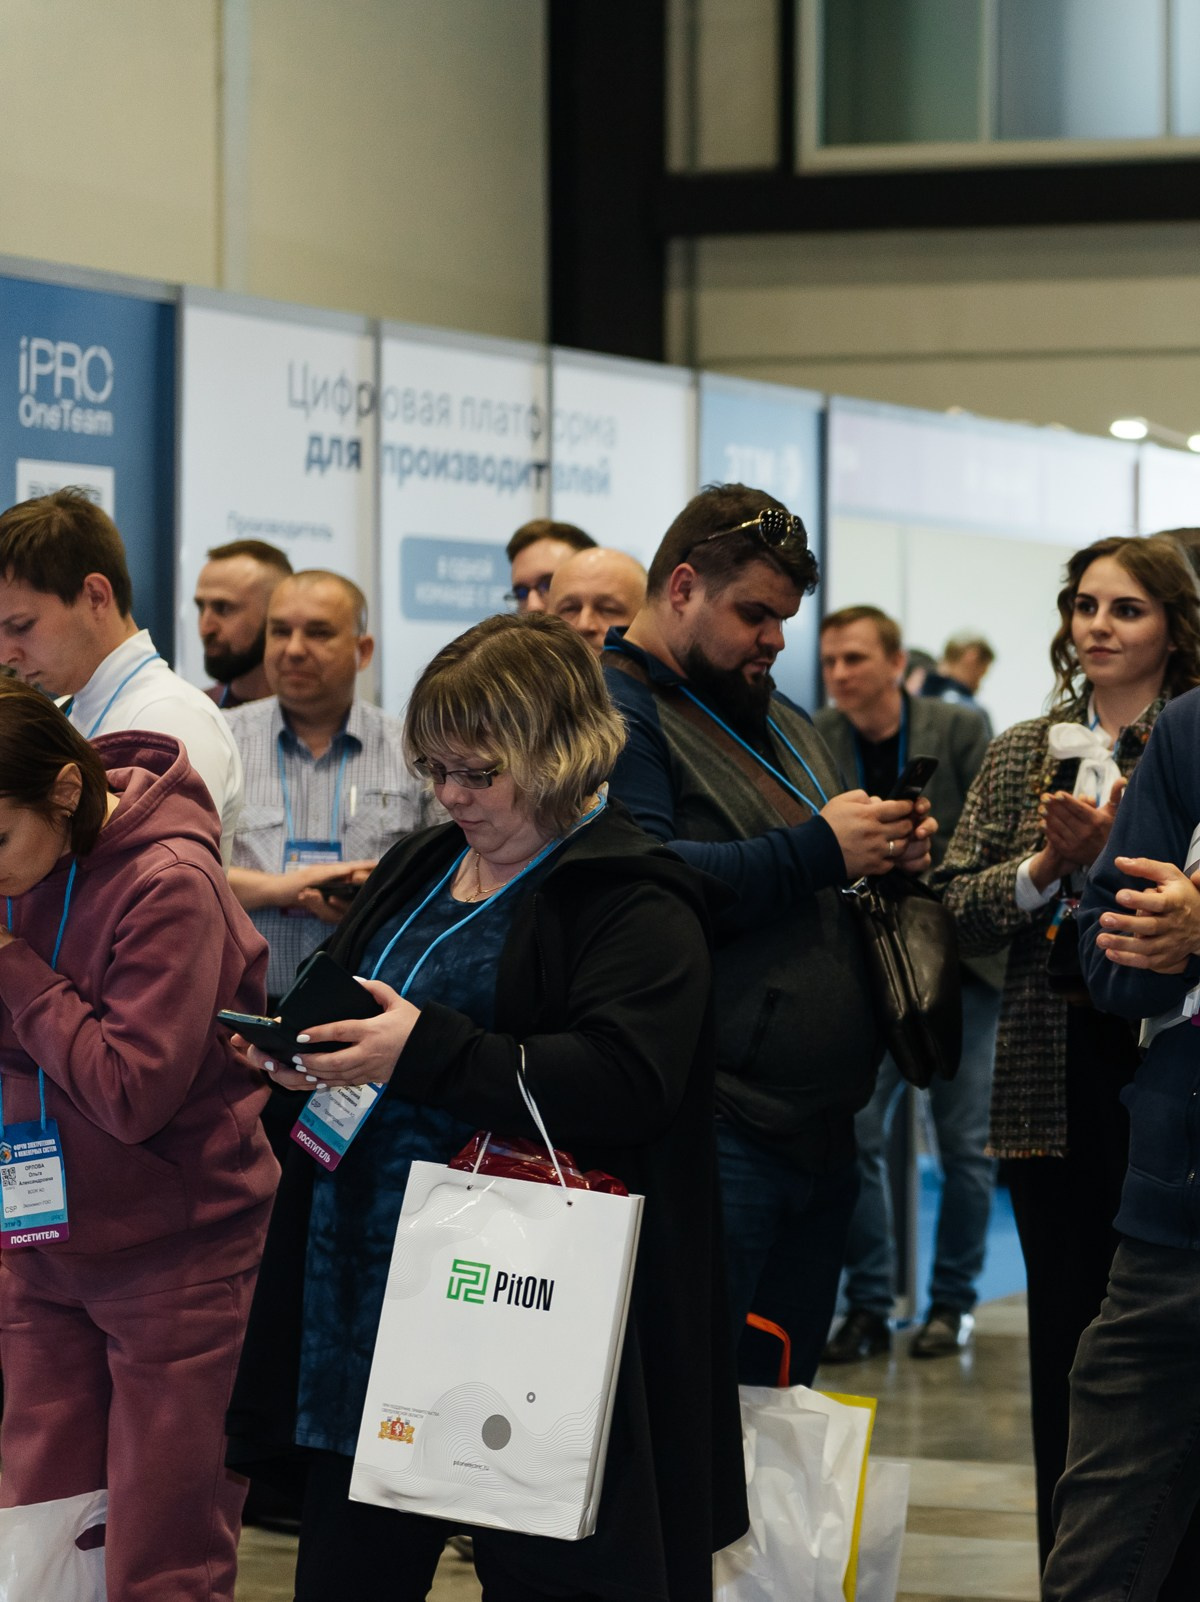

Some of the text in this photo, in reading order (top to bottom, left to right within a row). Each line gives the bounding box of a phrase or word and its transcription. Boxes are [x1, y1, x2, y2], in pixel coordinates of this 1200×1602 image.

[19, 335, 114, 403] iPRO
[19, 394, 114, 436] OneTeam
[305, 433, 362, 477] для
[296, 1130, 331, 1163] ПОСЕТИТЕЛЬ
[25, 1163, 45, 1171] ОРЛОВА
[11, 1231, 60, 1244] ПОСЕТИТЕЛЬ
[493, 1271, 555, 1311] PitON
